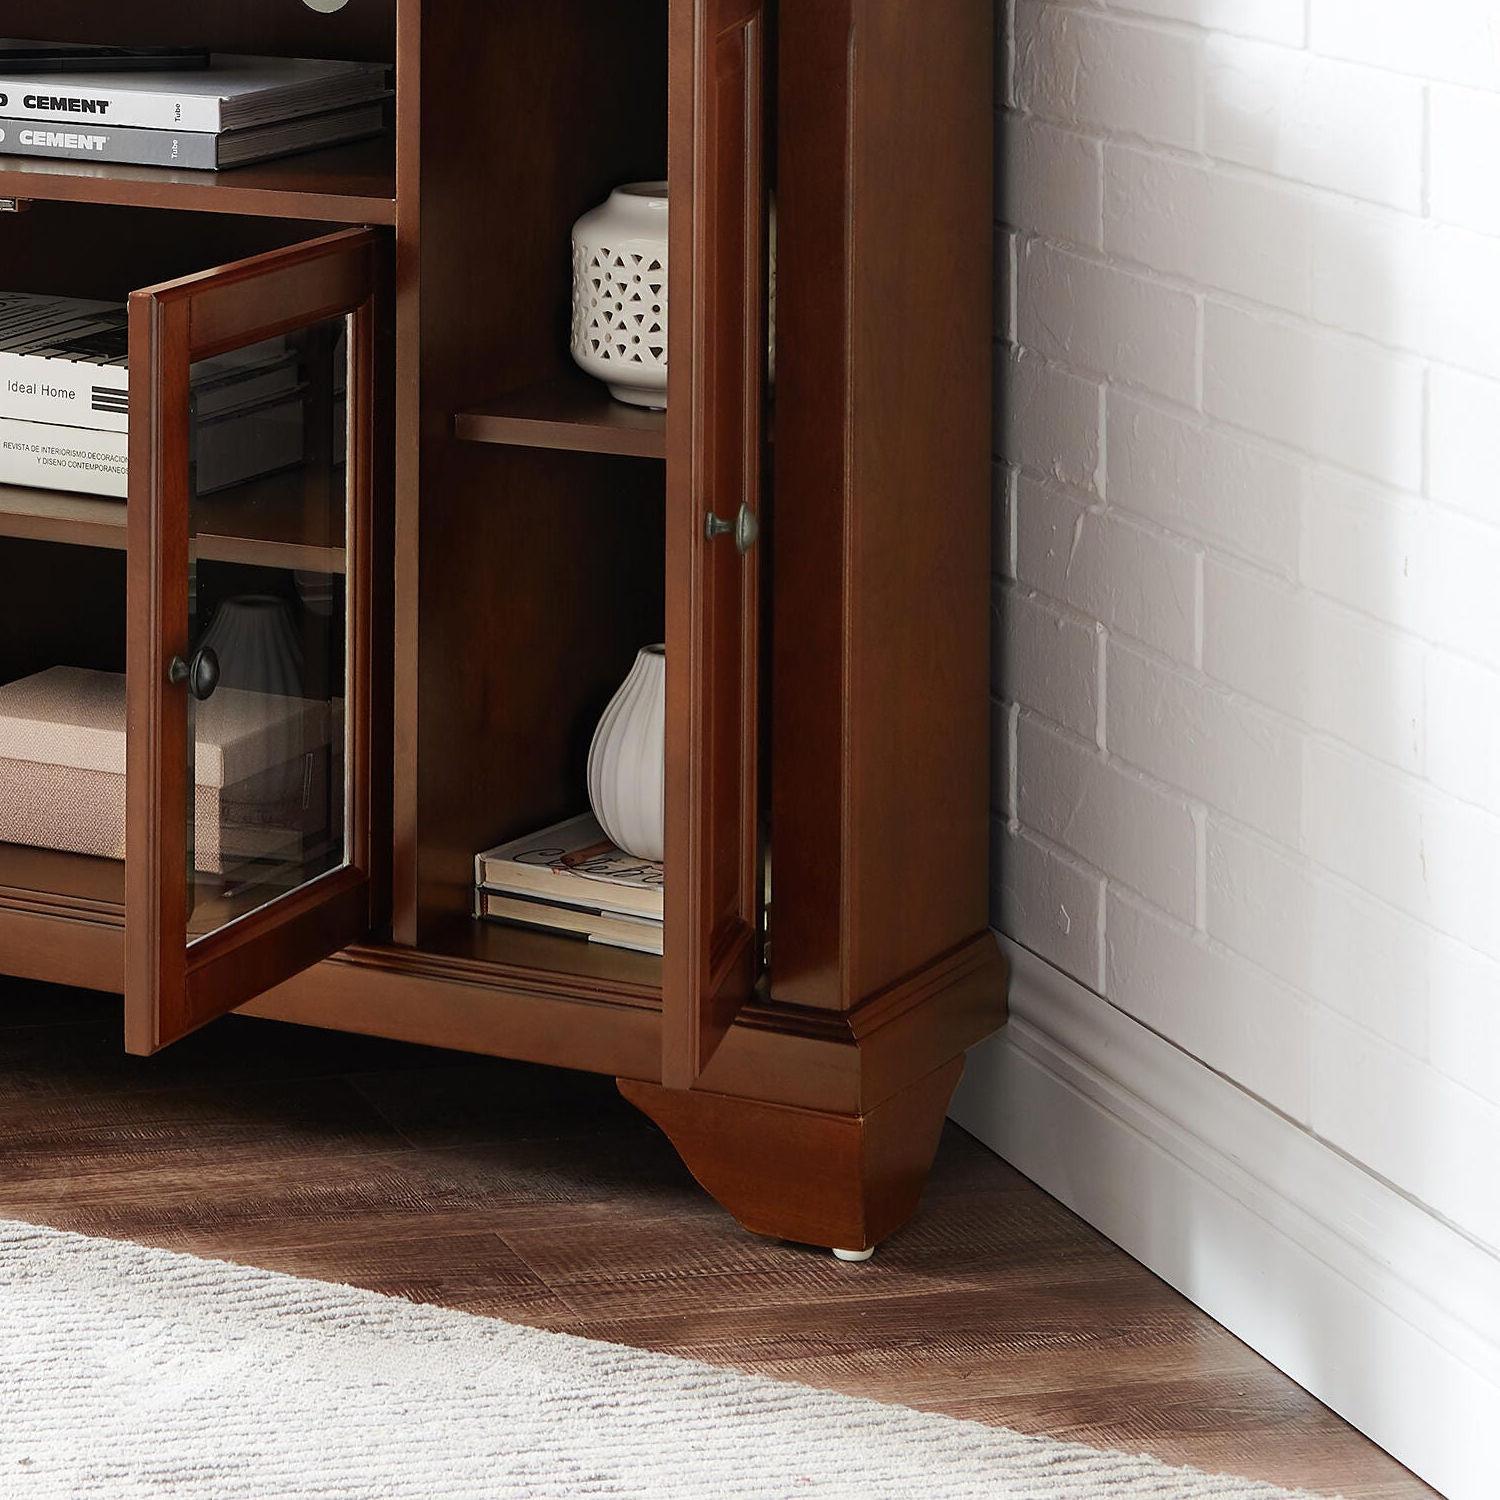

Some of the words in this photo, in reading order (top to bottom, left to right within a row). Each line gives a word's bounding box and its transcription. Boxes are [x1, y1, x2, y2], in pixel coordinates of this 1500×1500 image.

[23, 94, 110, 115] CEMENT
[19, 129, 108, 151] CEMENT
[7, 380, 36, 395] Ideal
[41, 385, 76, 400] Home
[3, 441, 29, 452] REVISTA
[30, 445, 40, 453] DE
